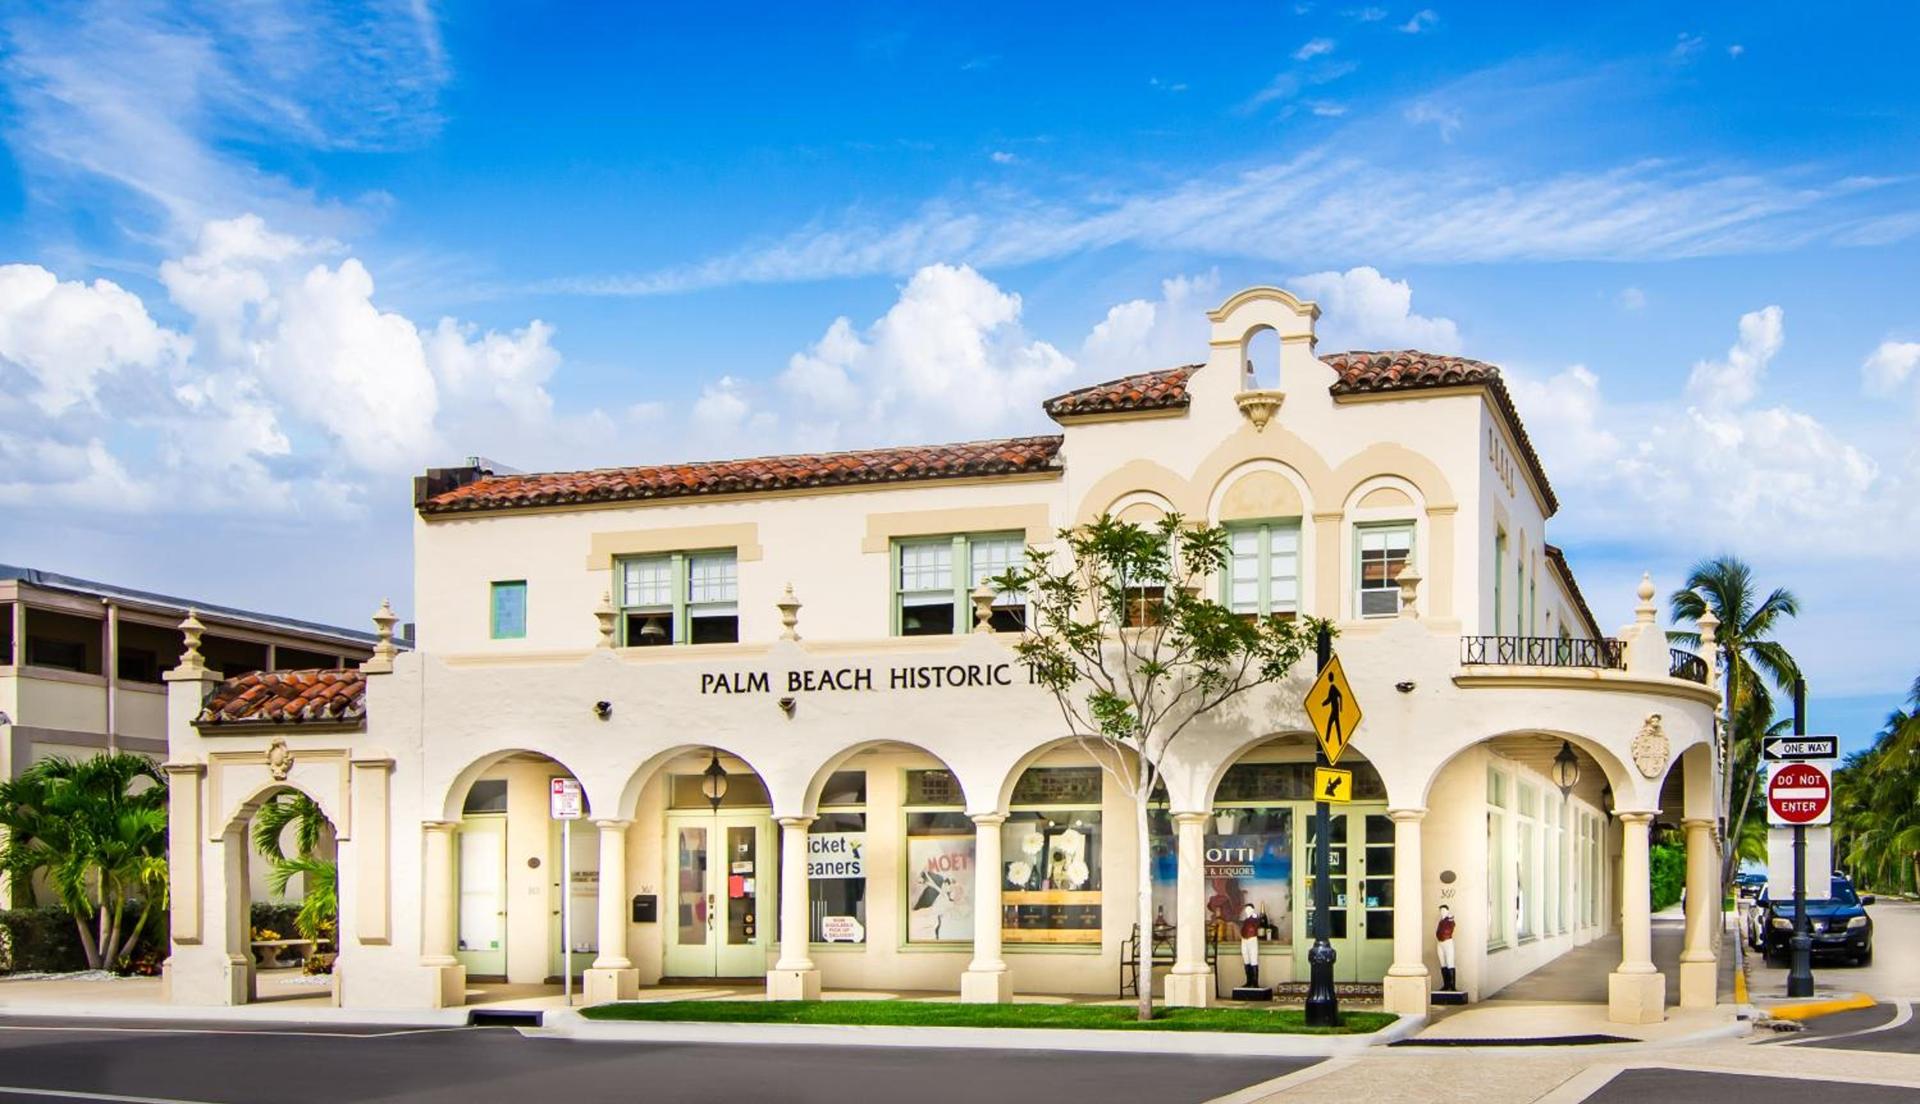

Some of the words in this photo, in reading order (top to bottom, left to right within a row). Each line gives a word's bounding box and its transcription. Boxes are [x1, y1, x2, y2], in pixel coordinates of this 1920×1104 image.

[701, 672, 770, 694] PALM
[788, 668, 872, 692] BEACH
[890, 664, 1012, 690] HISTORIC
[1784, 744, 1804, 754] ONE
[1808, 743, 1829, 752] WAY
[1778, 776, 1793, 785] DO
[1800, 775, 1821, 785] NOT
[1781, 802, 1816, 812] ENTER
[808, 836, 846, 853] icket
[1206, 848, 1254, 862] OTTI
[808, 861, 861, 875] eaners
[1219, 867, 1255, 877] LIQUORS
